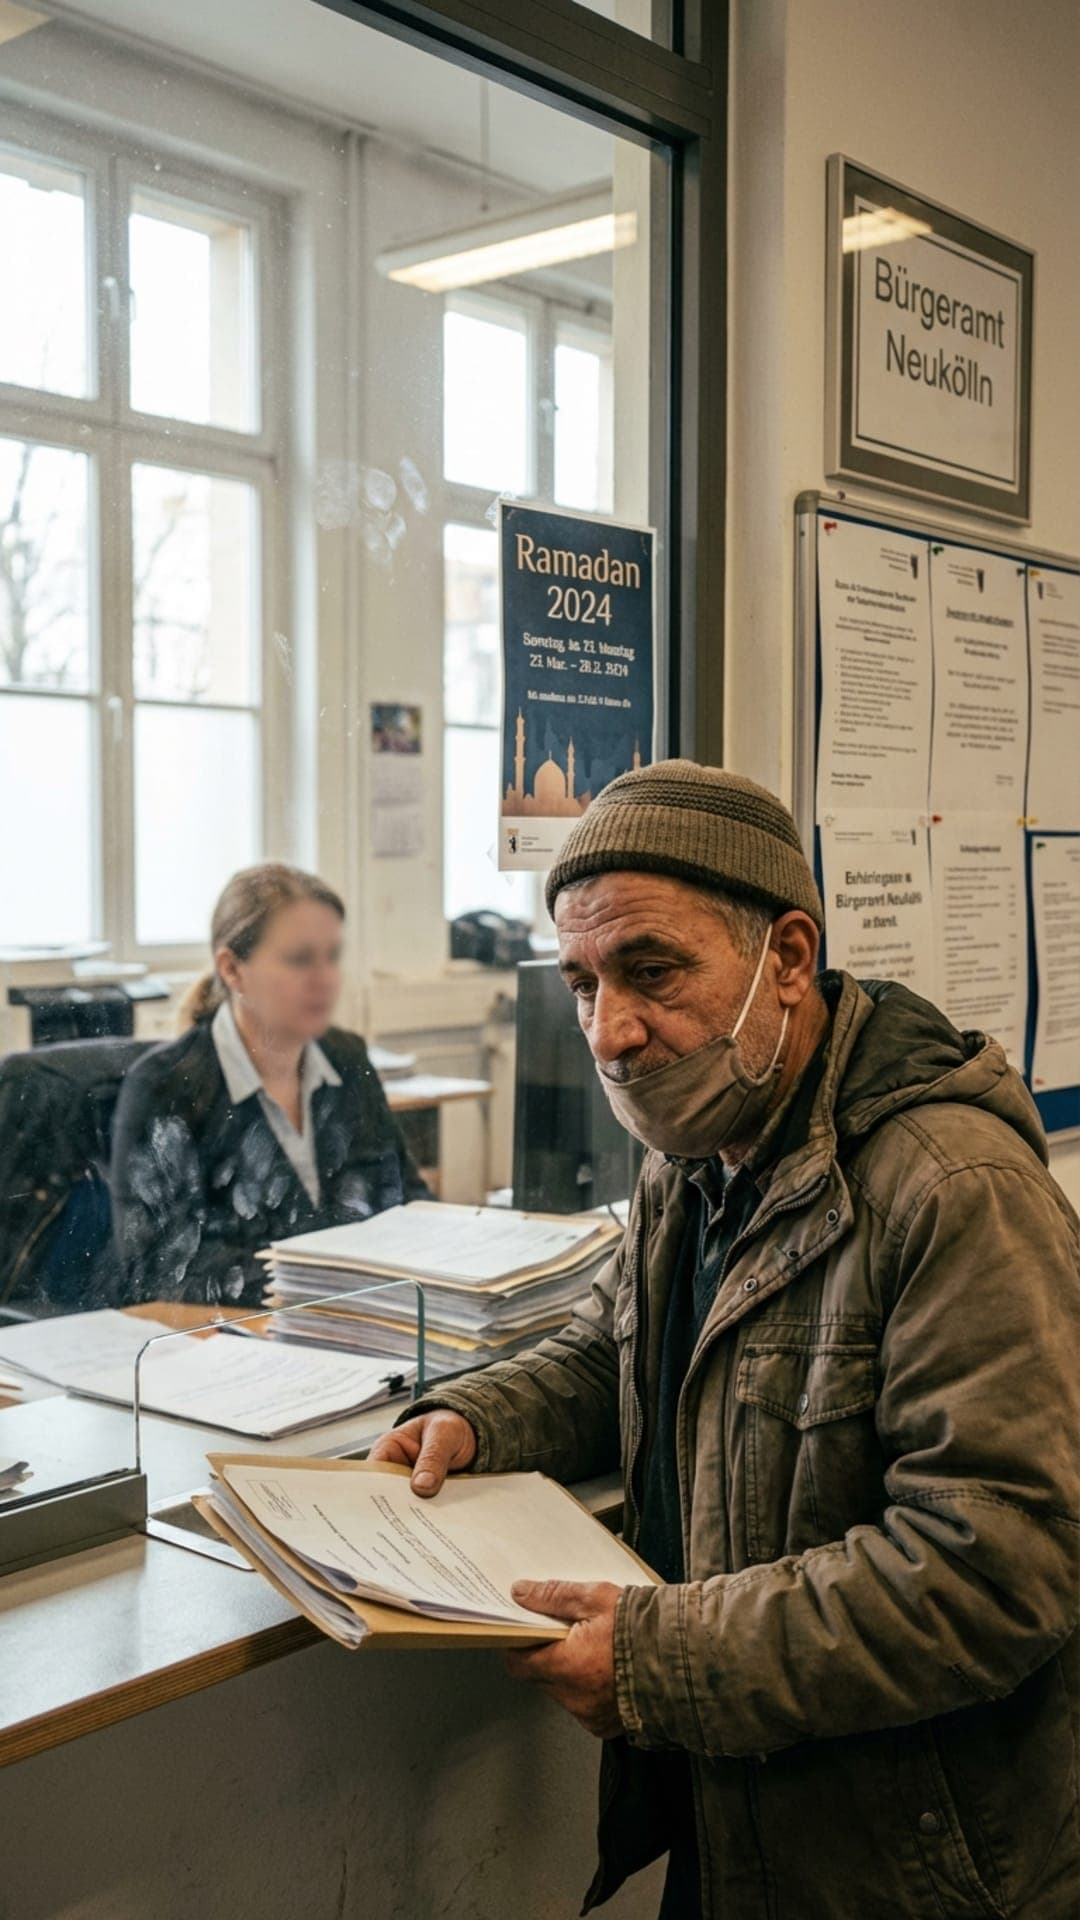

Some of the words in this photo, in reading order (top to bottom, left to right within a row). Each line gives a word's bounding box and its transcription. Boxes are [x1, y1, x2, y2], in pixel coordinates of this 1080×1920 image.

[875, 256, 1005, 349] Bürgeramt
[886, 329, 993, 407] Neukölln
[515, 533, 640, 589] Ramadan
[547, 585, 613, 626] 2024
